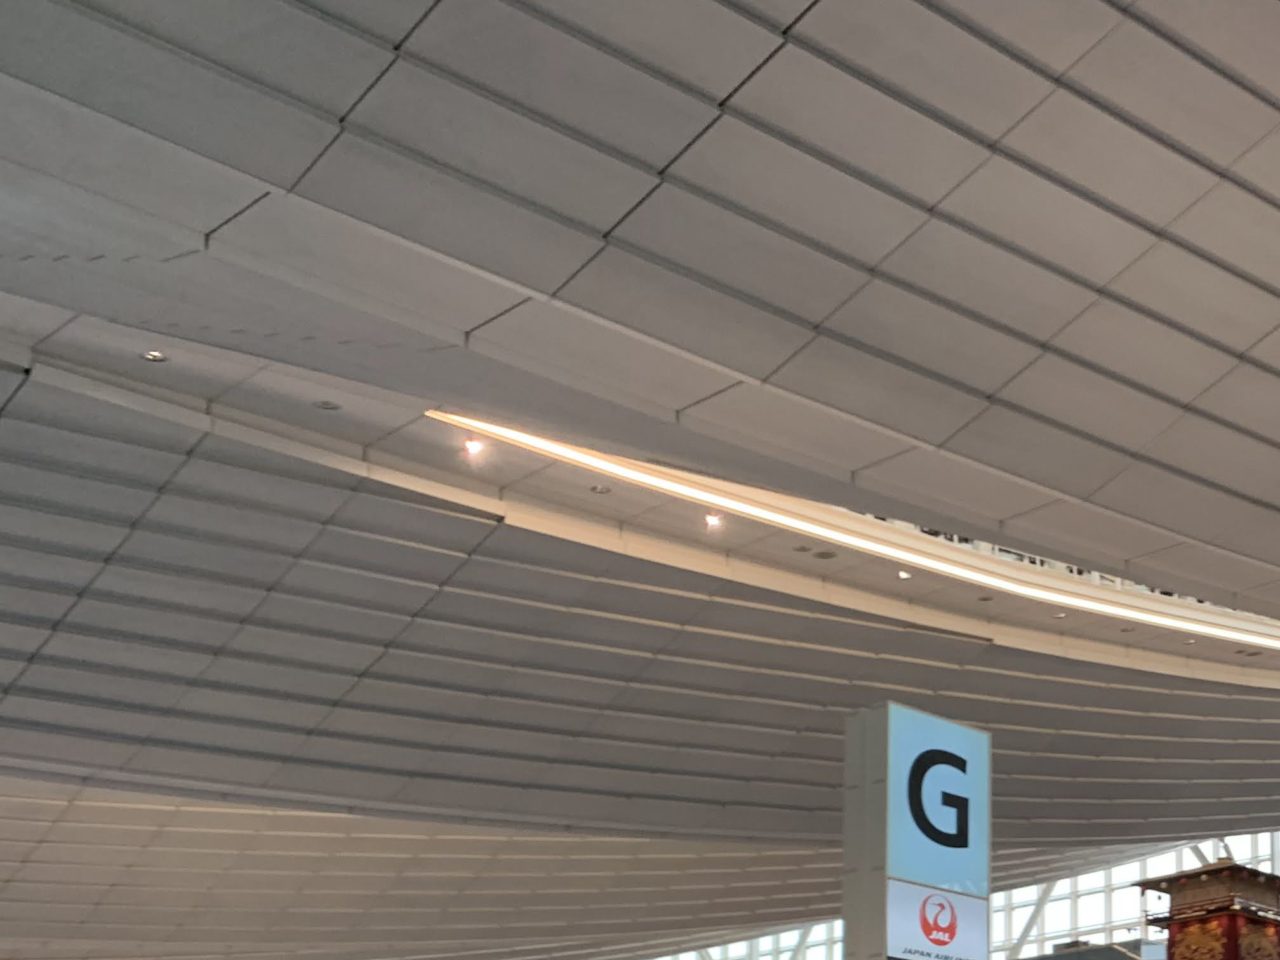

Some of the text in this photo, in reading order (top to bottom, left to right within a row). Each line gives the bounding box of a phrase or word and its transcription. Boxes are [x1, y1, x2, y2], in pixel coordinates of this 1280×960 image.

[908, 748, 969, 849] G
[929, 931, 951, 942] JAL
[902, 947, 932, 958] JAPAN
